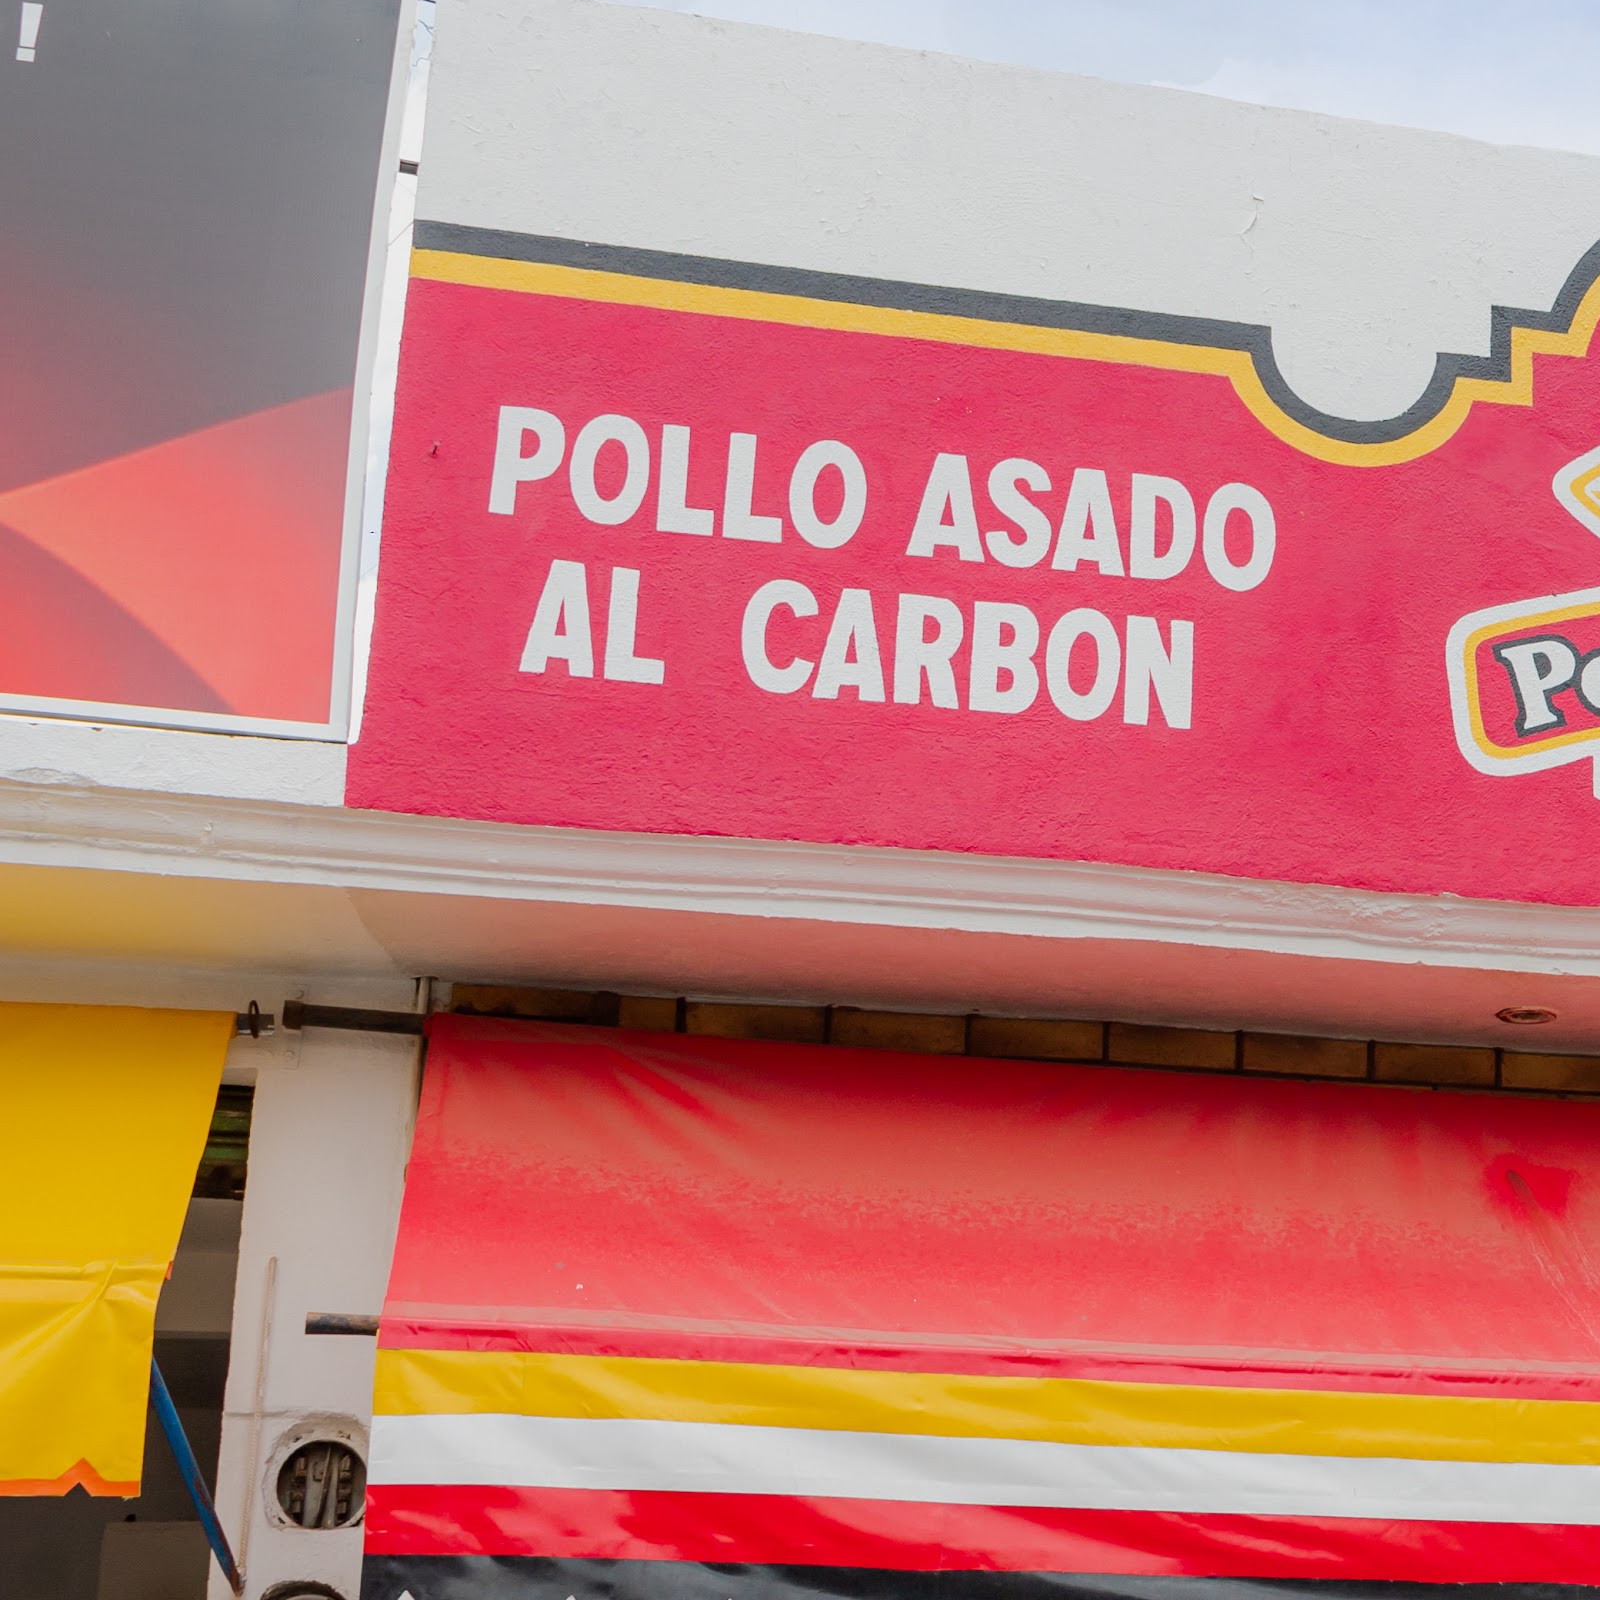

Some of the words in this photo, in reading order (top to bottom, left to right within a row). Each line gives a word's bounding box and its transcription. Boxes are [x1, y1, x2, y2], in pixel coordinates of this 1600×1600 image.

[488, 404, 868, 550] POLLO
[906, 453, 1278, 593] ASADO
[518, 558, 665, 686] AL
[741, 579, 1196, 730] CARBON
